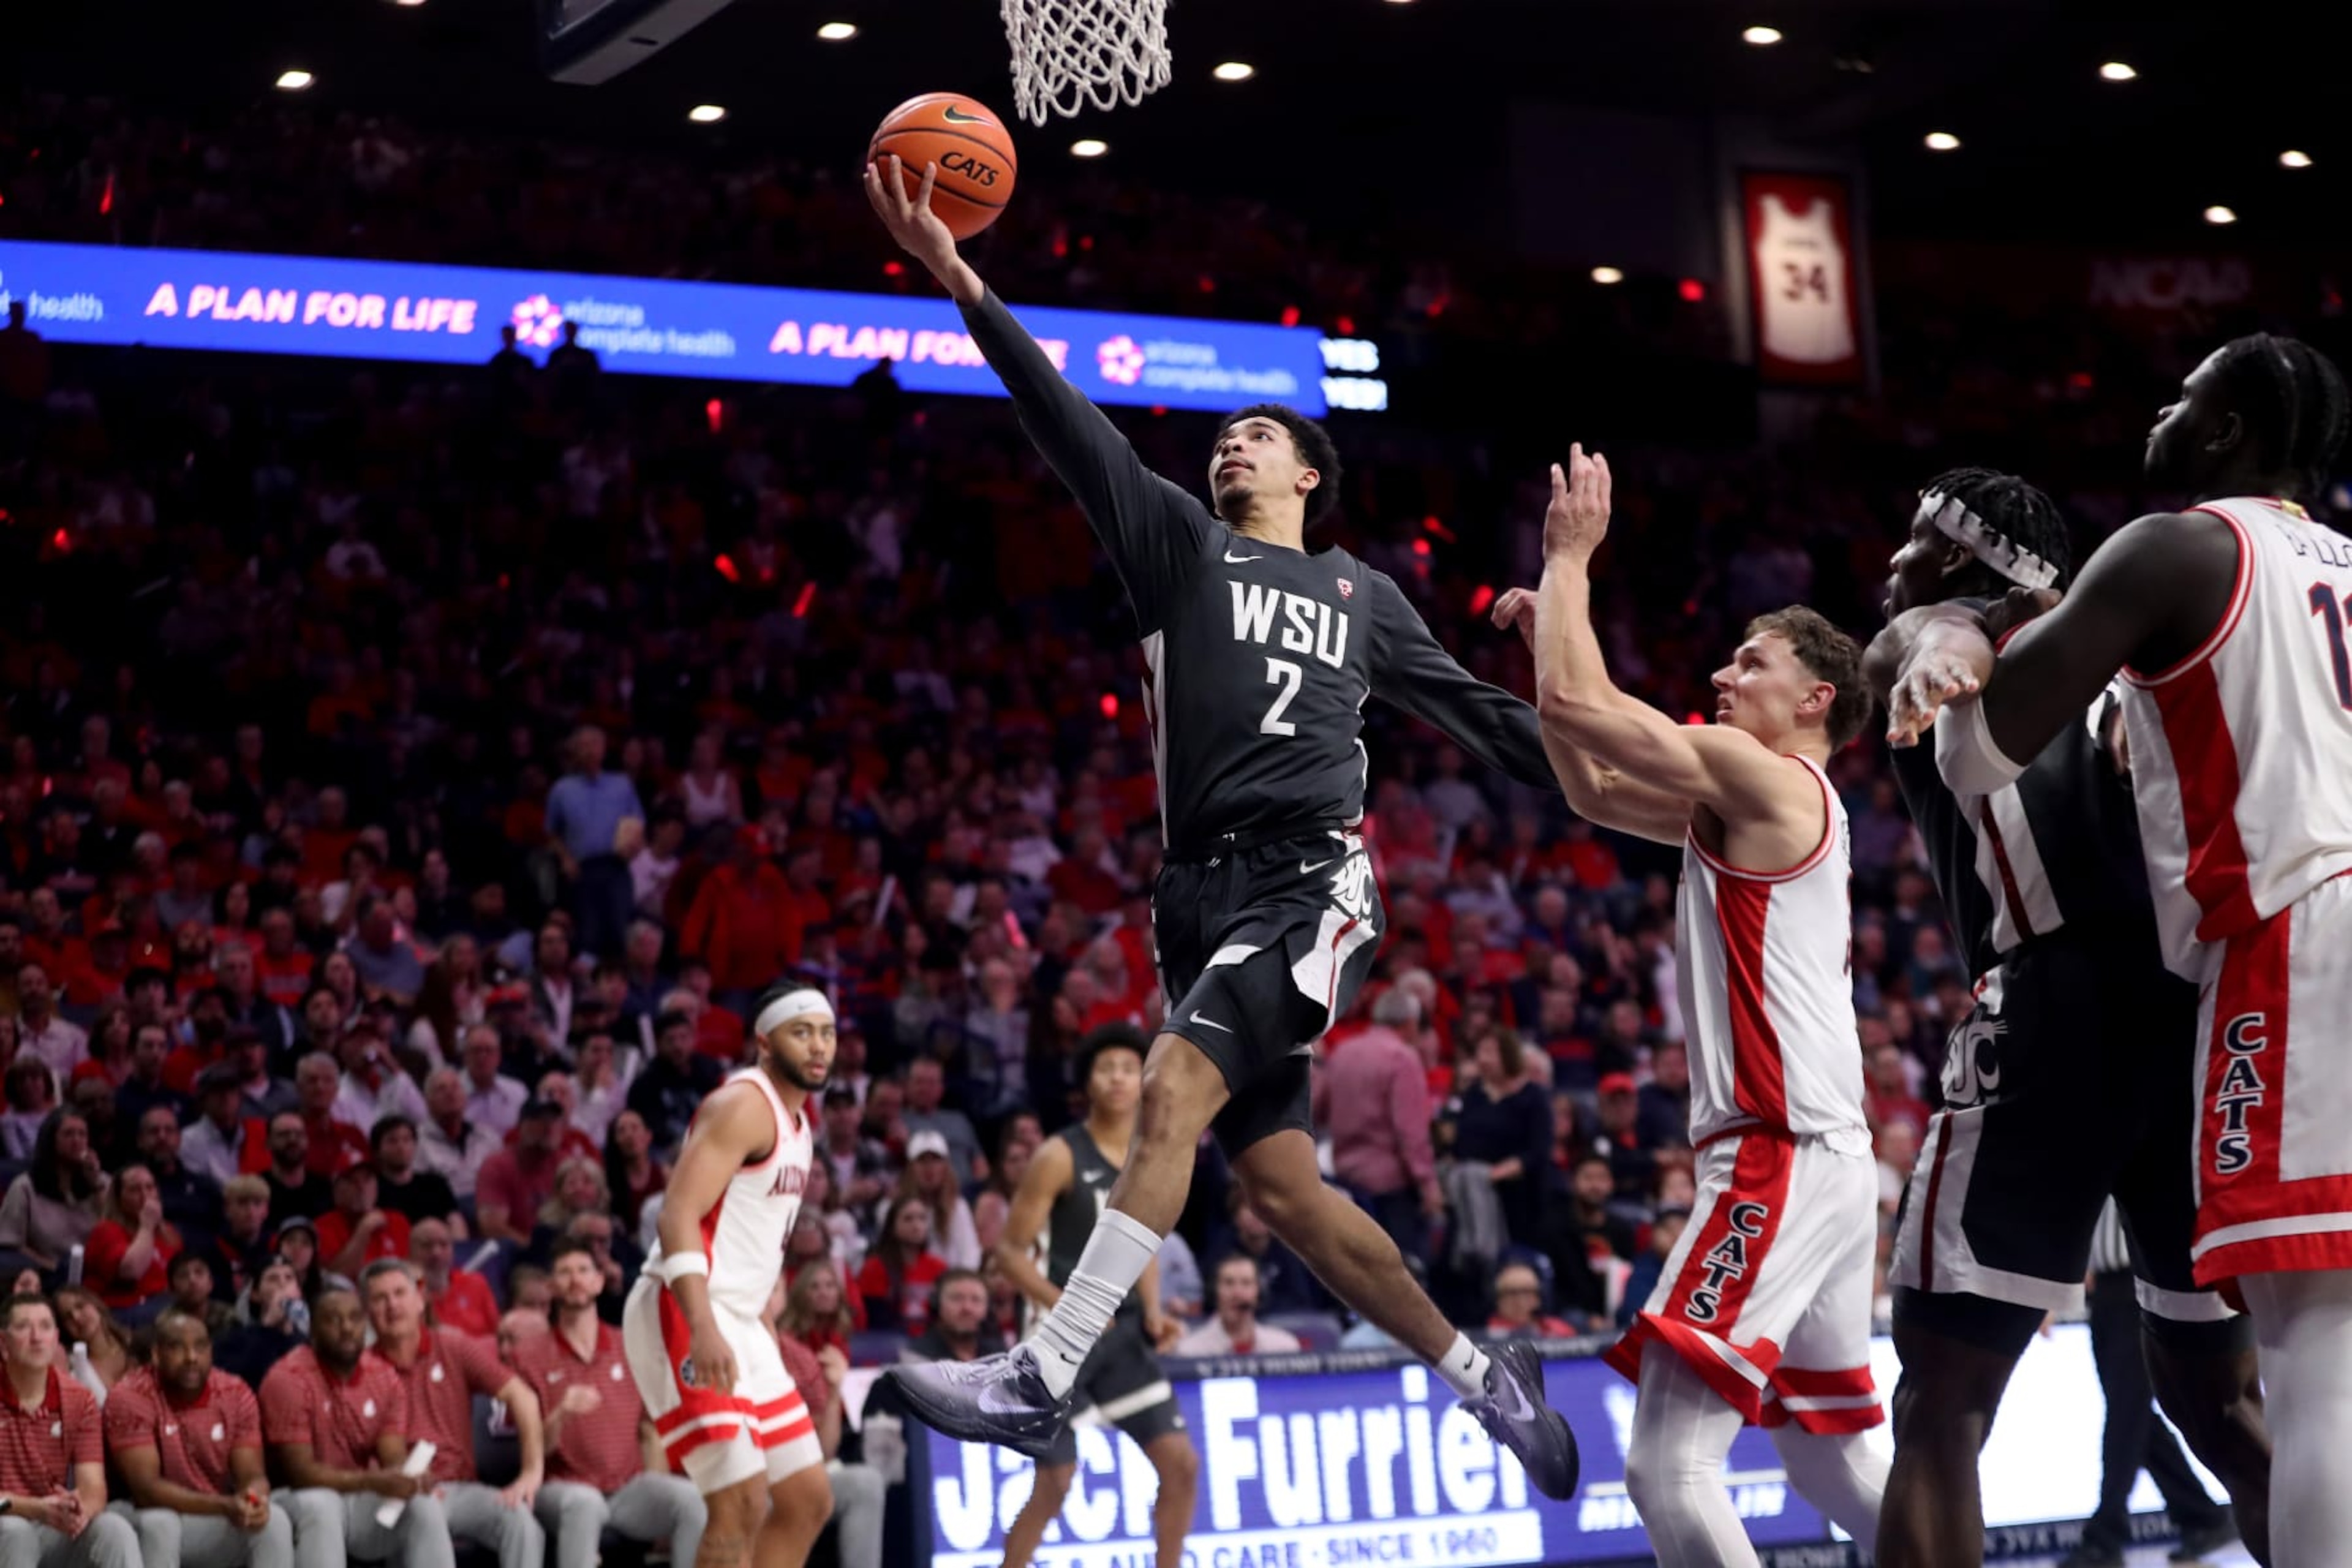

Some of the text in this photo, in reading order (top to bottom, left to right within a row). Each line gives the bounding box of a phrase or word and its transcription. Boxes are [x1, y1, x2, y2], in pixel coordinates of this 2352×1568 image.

[940, 151, 1000, 186] CATS
[1782, 262, 1828, 304] 34
[29, 290, 104, 323] health
[145, 283, 477, 334] A PLAN FOR LIFE
[769, 320, 803, 354] A
[807, 323, 909, 361] PLAN
[1227, 579, 1349, 669] WSU
[1260, 657, 1303, 736] 2
[2215, 1012, 2267, 1174] CATS
[1685, 1202, 1769, 1324] CATS
[1327, 1534, 1415, 1566] SINCE
